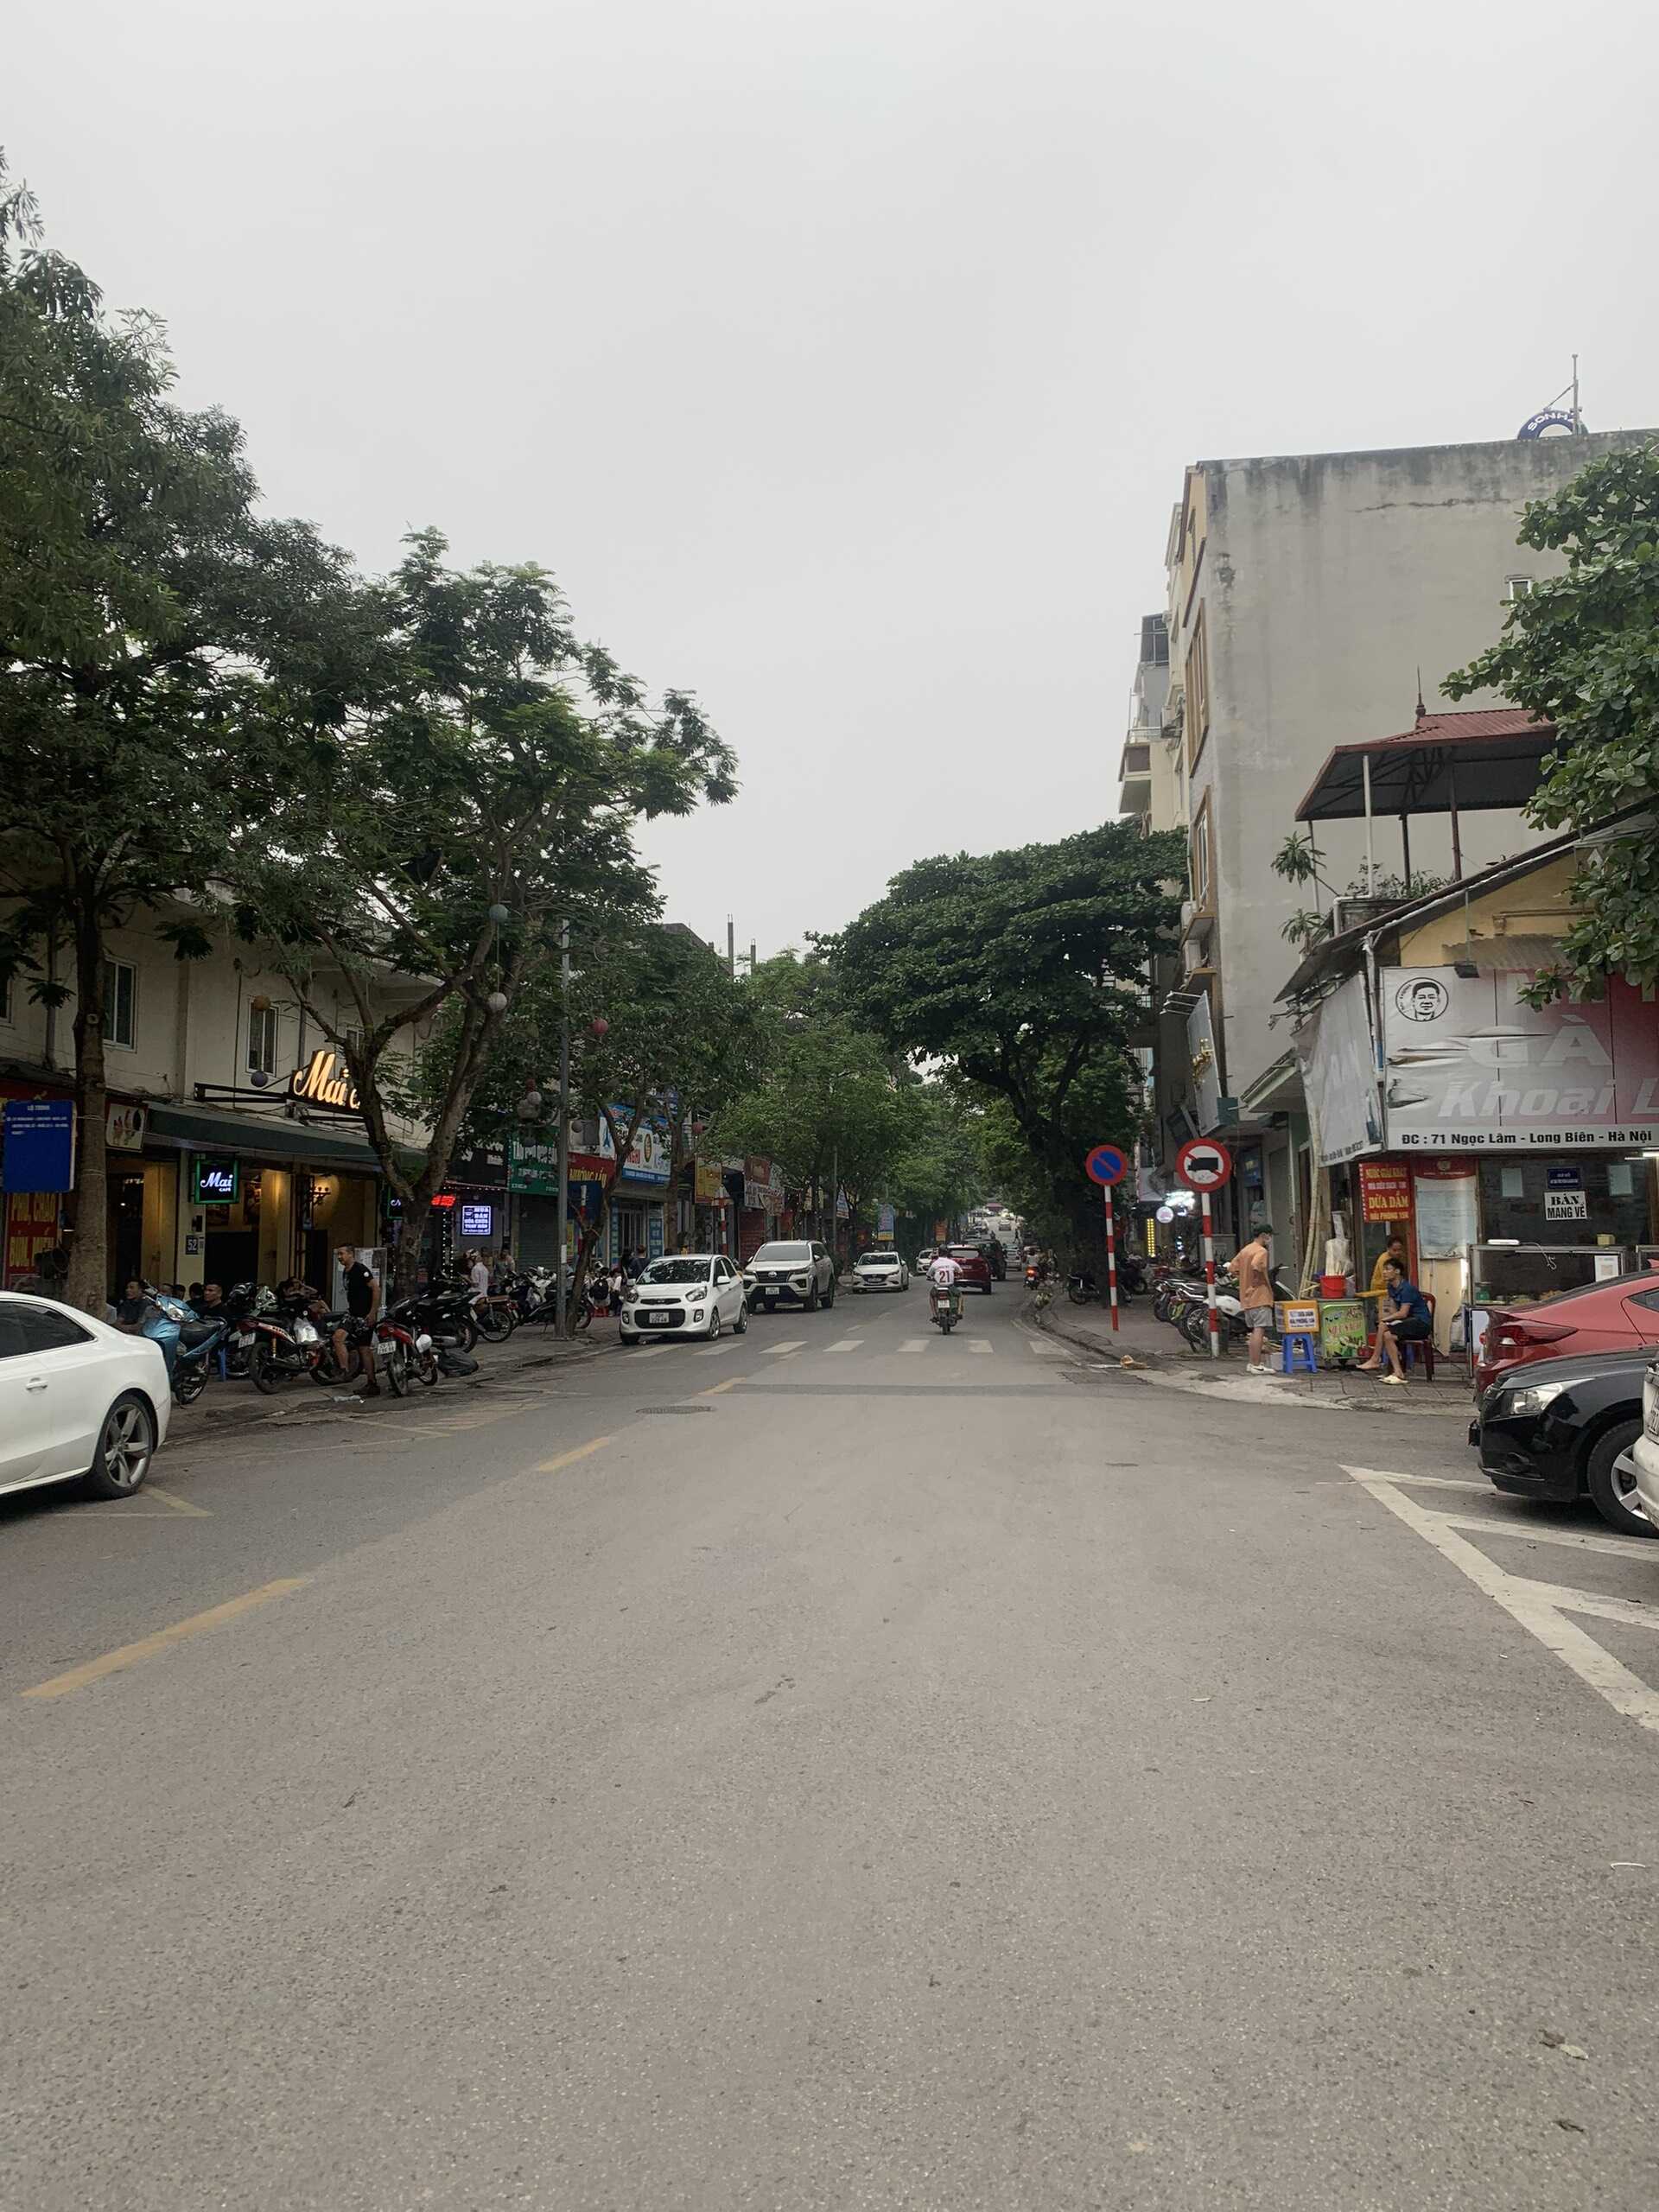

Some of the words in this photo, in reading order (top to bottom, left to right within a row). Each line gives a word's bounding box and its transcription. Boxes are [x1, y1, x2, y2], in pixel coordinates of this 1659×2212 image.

[1469, 1014, 1615, 1069] GÀ
[294, 1050, 349, 1106] Mai
[1438, 1079, 1615, 1117] Khoai
[1402, 1134, 1420, 1145] ĐC
[1431, 1134, 1446, 1145] 71
[1451, 1134, 1484, 1147] Ngọc
[1489, 1133, 1516, 1144] Lâm
[1529, 1133, 1561, 1144] Long
[1565, 1131, 1595, 1143] Biên
[1608, 1131, 1625, 1142] Hà
[1629, 1130, 1653, 1143] Nội
[200, 1172, 233, 1188] Mai
[1550, 1193, 1580, 1206] BÁN
[1547, 1206, 1573, 1219] MANG
[188, 1239, 198, 1251] 52
[939, 1270, 950, 1283] 21
